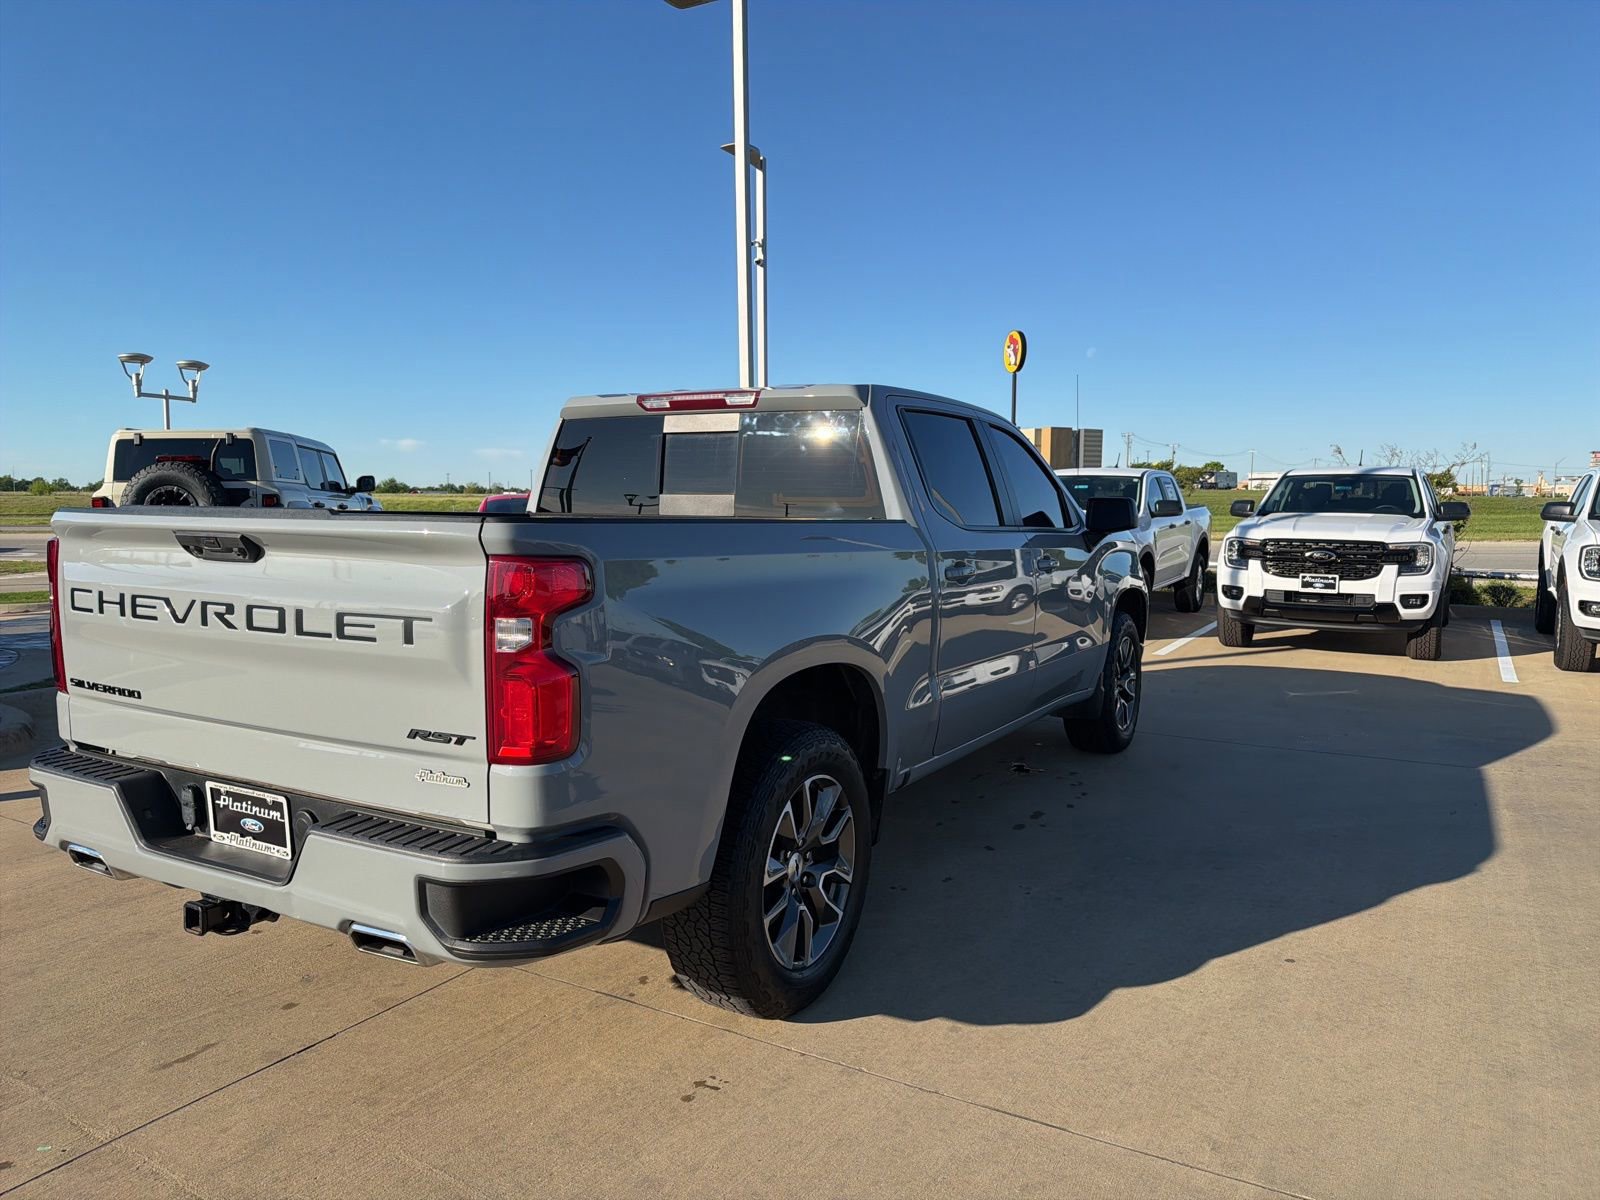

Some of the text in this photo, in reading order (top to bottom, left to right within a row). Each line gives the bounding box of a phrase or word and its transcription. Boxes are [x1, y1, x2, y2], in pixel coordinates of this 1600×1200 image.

[70, 587, 433, 645] CHEVROLET
[69, 677, 142, 700] SILVERADO
[406, 728, 477, 746] RST
[415, 768, 469, 788] Platinum
[215, 795, 285, 822] Platinum
[227, 833, 275, 854] Platinum
